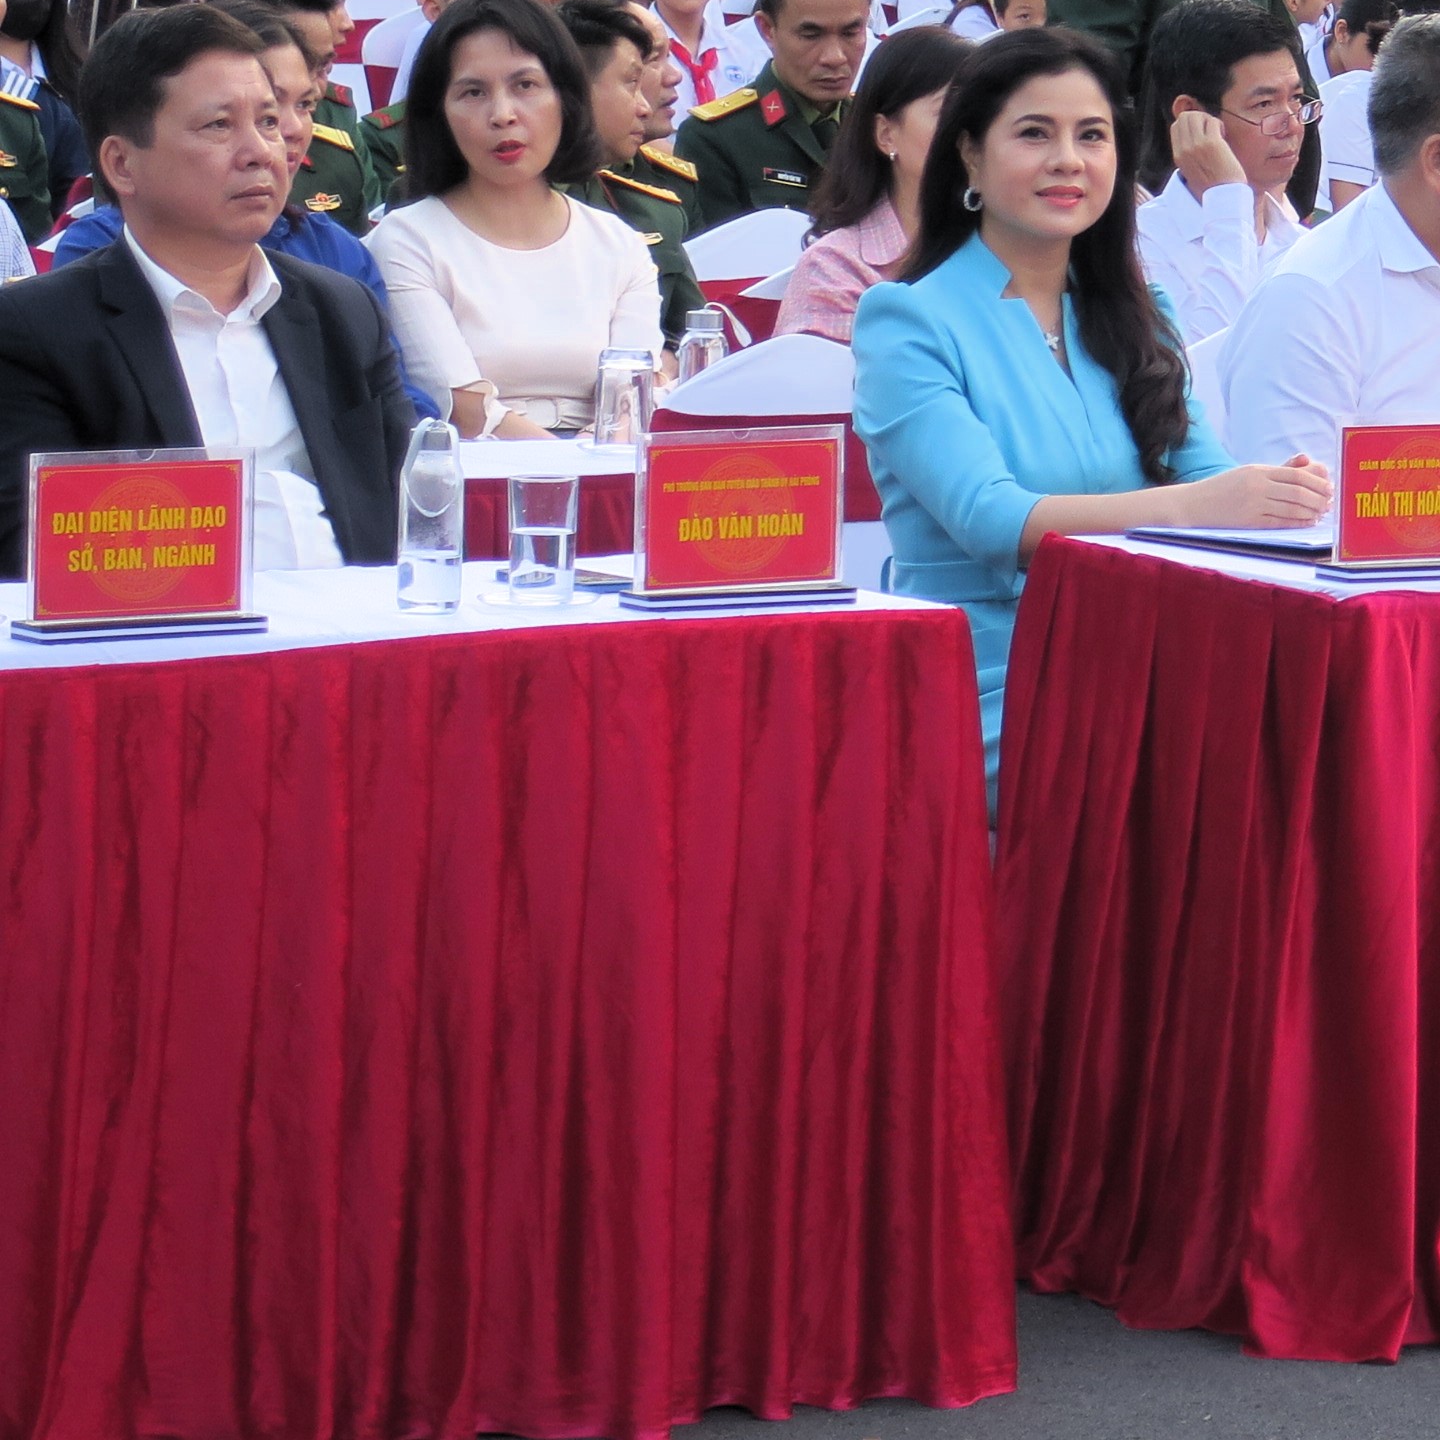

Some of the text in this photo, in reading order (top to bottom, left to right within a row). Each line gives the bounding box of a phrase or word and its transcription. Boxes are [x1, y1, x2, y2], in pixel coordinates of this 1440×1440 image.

[1355, 484, 1389, 518] TRẦN
[1394, 491, 1413, 523] THỊ
[53, 504, 227, 539] ĐẠI DIỆN LÃNH ĐẠO
[679, 509, 804, 542] ĐÀO VĂN HOÀN
[68, 540, 216, 574] SỞ, BAN, NGÀNH
